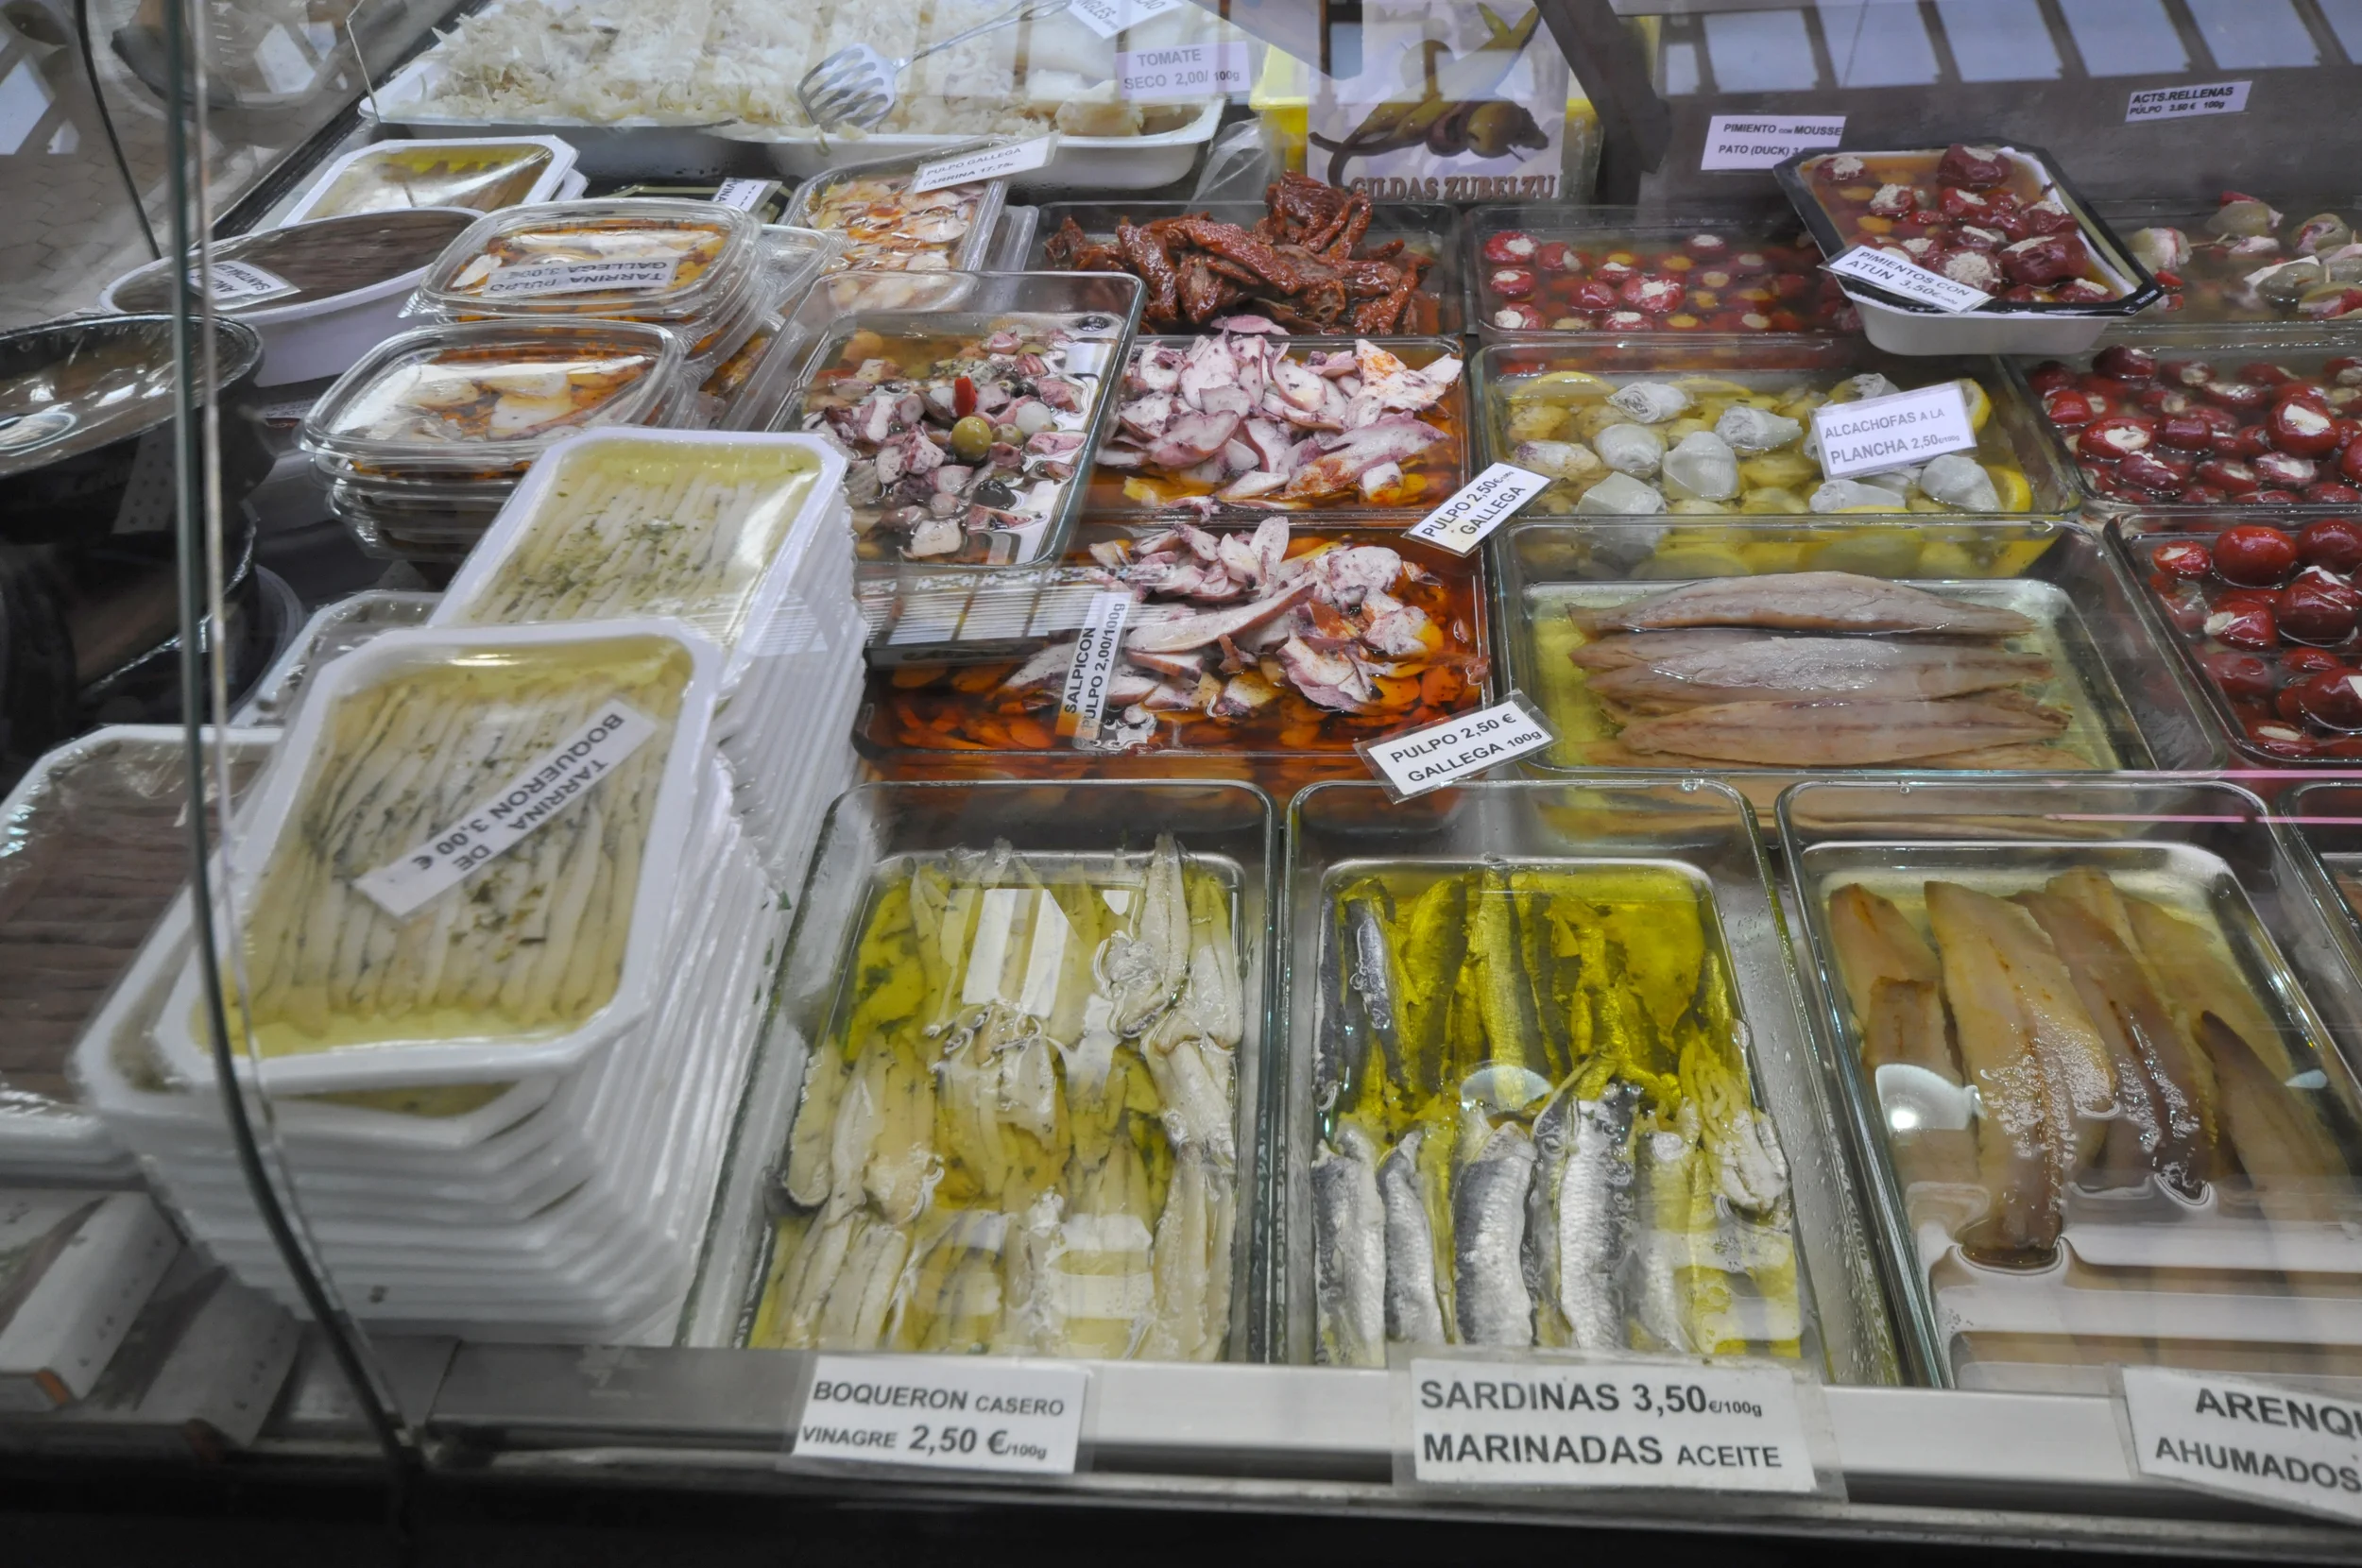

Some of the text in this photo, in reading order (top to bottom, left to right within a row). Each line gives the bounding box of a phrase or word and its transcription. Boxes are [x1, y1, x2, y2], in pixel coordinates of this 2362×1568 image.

[1137, 48, 1202, 67] TOMATE
[1124, 75, 1167, 90] SECO
[1213, 70, 1241, 81] 100g
[2203, 100, 2225, 110] 100g
[1723, 123, 1777, 134] PIMIENTO
[1793, 125, 1842, 136] MOUSSE
[926, 147, 1021, 176] PULPO GALLEGA
[1718, 145, 1749, 154] PATO
[1751, 145, 1789, 157] (DUCK)
[923, 170, 976, 187] TARRINA
[1349, 175, 1556, 201] GILDAS ZUBELZU
[489, 272, 663, 292] TARRINA PULPO
[567, 261, 667, 273] GALLEGA
[1846, 260, 1895, 281] ATUN
[1858, 251, 1971, 296] PIMIENTOS CON
[1824, 408, 1945, 438] ALCACHOFAS A LA
[1830, 438, 1908, 464] PLANCHA
[1421, 502, 1471, 537] PULPO
[1460, 486, 1527, 536] GALLEGA
[1065, 627, 1096, 714] SALPICON
[1082, 604, 1125, 729] PULPO 2,00/100g
[1390, 713, 1517, 763] PULPO 2,50 €
[488, 713, 625, 820] BOQUERON
[1408, 730, 1542, 782] GALLEGA 100g
[452, 758, 610, 871] TARRINA DE
[411, 854, 435, 871] €
[813, 1381, 1065, 1417] BOQUERON CASERO
[1420, 1380, 1619, 1412] SARDINAS
[802, 1426, 899, 1448] VINAGRE
[908, 1424, 977, 1457] 2,50
[1424, 1433, 1783, 1468] MARINADAS ACEITE
[2155, 1437, 2362, 1493] AHUMADOS
